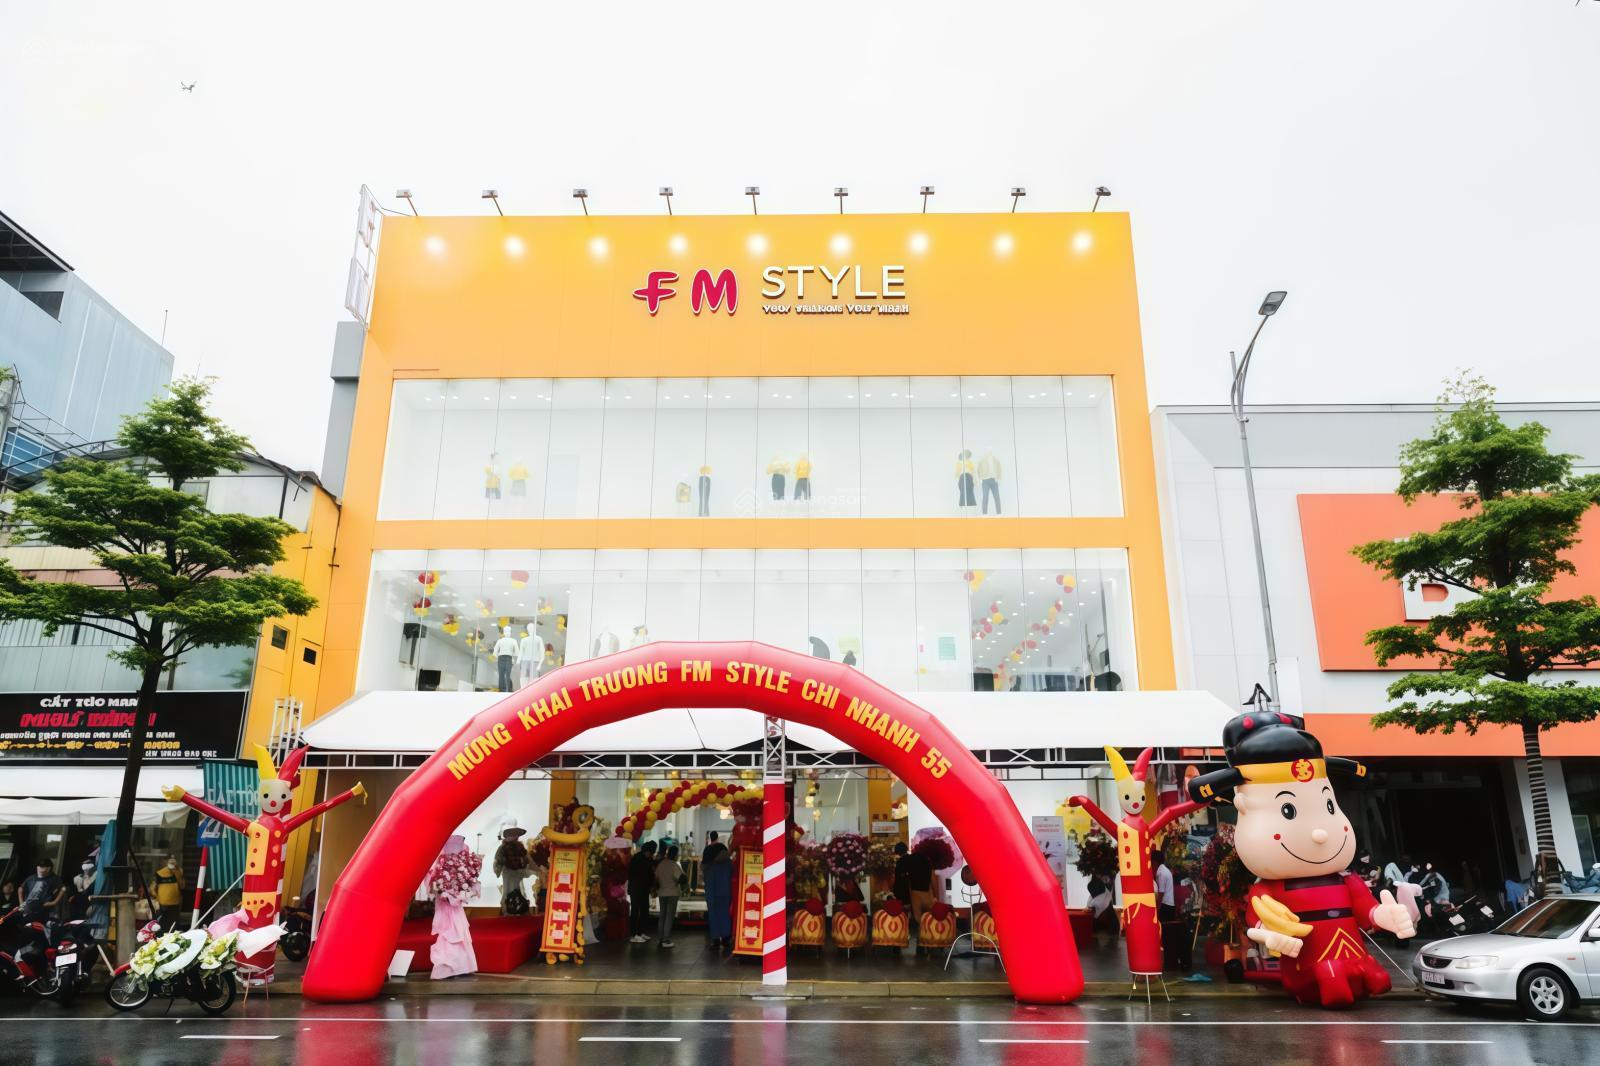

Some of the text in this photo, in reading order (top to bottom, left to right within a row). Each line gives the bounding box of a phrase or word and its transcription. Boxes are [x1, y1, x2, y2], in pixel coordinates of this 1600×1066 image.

[762, 265, 906, 298] STYLE
[516, 686, 574, 732] KHAI
[680, 660, 712, 682] FM
[725, 661, 792, 694] STYLE
[801, 678, 841, 710] CHI
[844, 696, 921, 753] NHANH
[921, 747, 953, 779] 55
